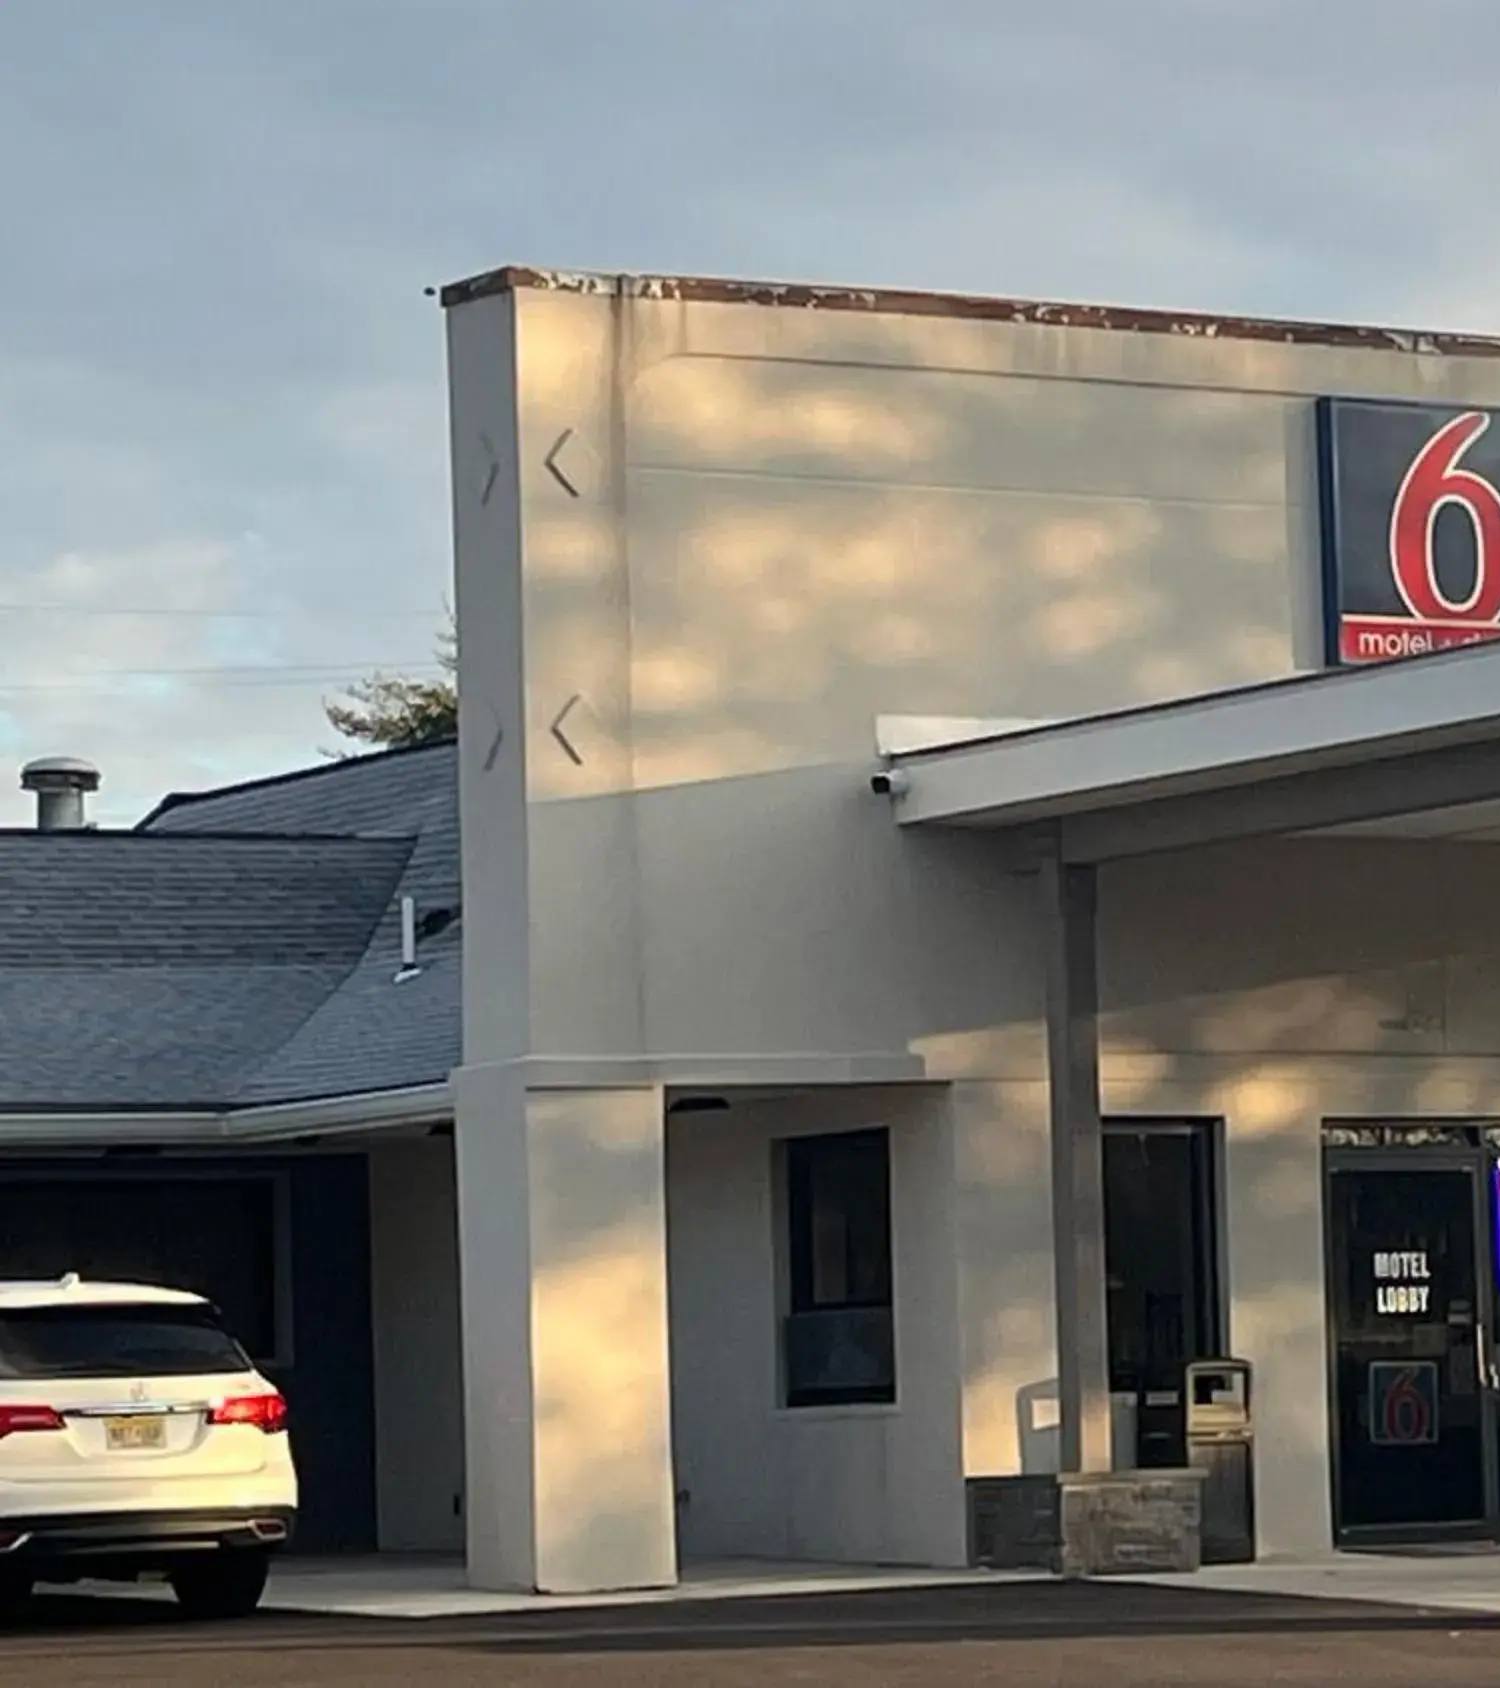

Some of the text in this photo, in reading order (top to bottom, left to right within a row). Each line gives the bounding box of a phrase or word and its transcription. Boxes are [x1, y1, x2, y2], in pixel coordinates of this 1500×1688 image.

[1358, 629, 1433, 656] motel
[1374, 1251, 1431, 1279] MOTEL
[1377, 1285, 1429, 1313] LOBBY
[1383, 1364, 1430, 1441] 6
